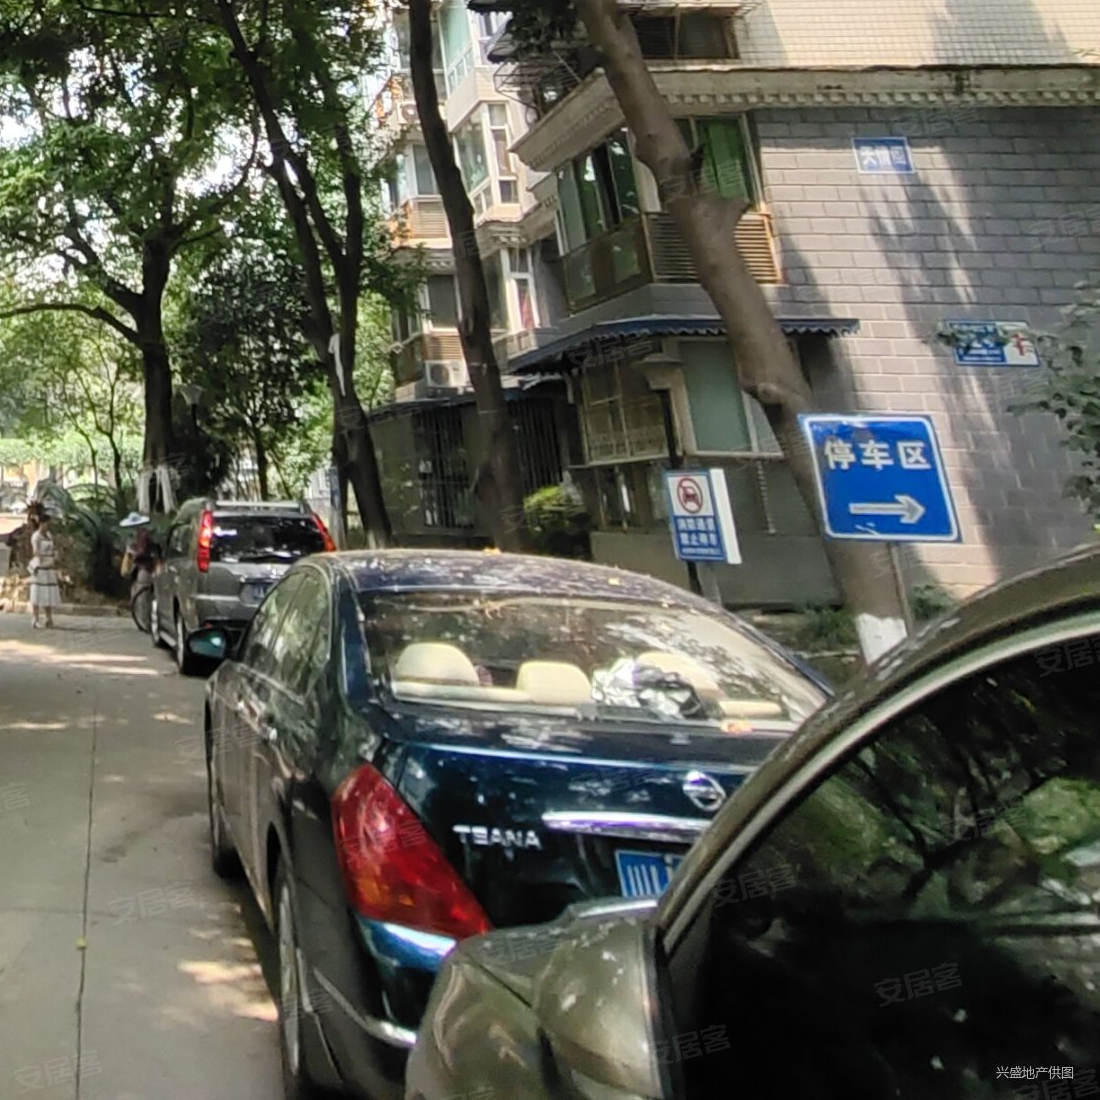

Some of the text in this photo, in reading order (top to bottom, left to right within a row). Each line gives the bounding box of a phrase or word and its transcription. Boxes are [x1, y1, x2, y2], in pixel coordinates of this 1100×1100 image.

[824, 439, 931, 470] 停车区
[453, 824, 541, 849] TEANA
